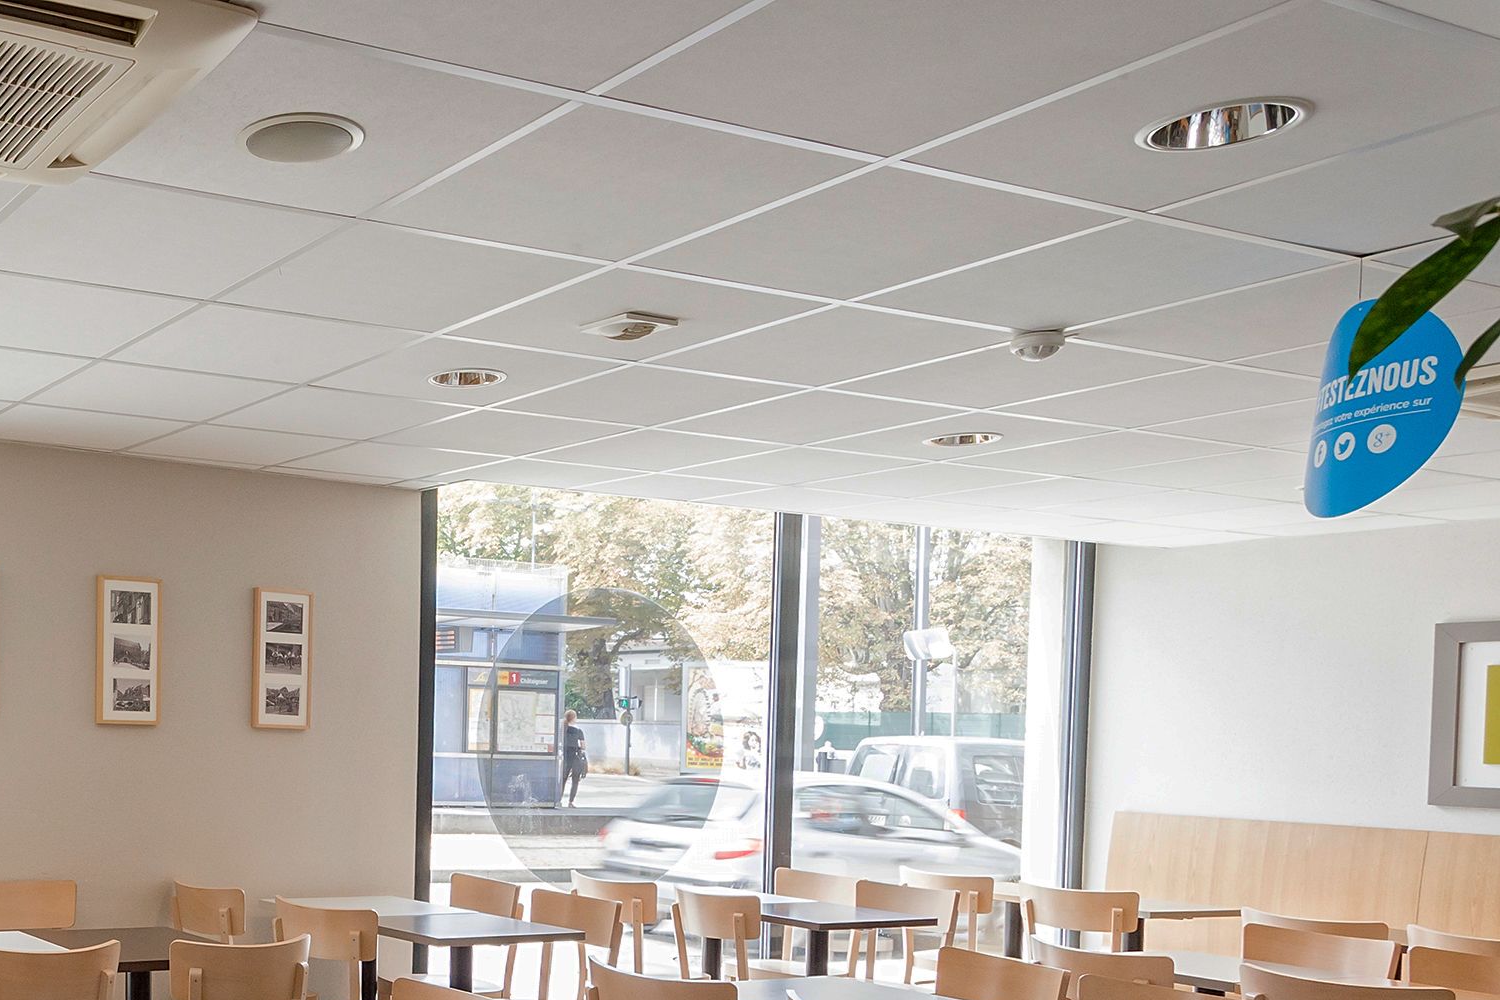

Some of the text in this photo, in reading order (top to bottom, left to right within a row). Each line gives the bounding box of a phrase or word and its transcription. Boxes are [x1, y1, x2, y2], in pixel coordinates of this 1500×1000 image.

[1354, 399, 1411, 418] expérience
[1412, 397, 1433, 408] sur
[511, 673, 517, 684] 1
